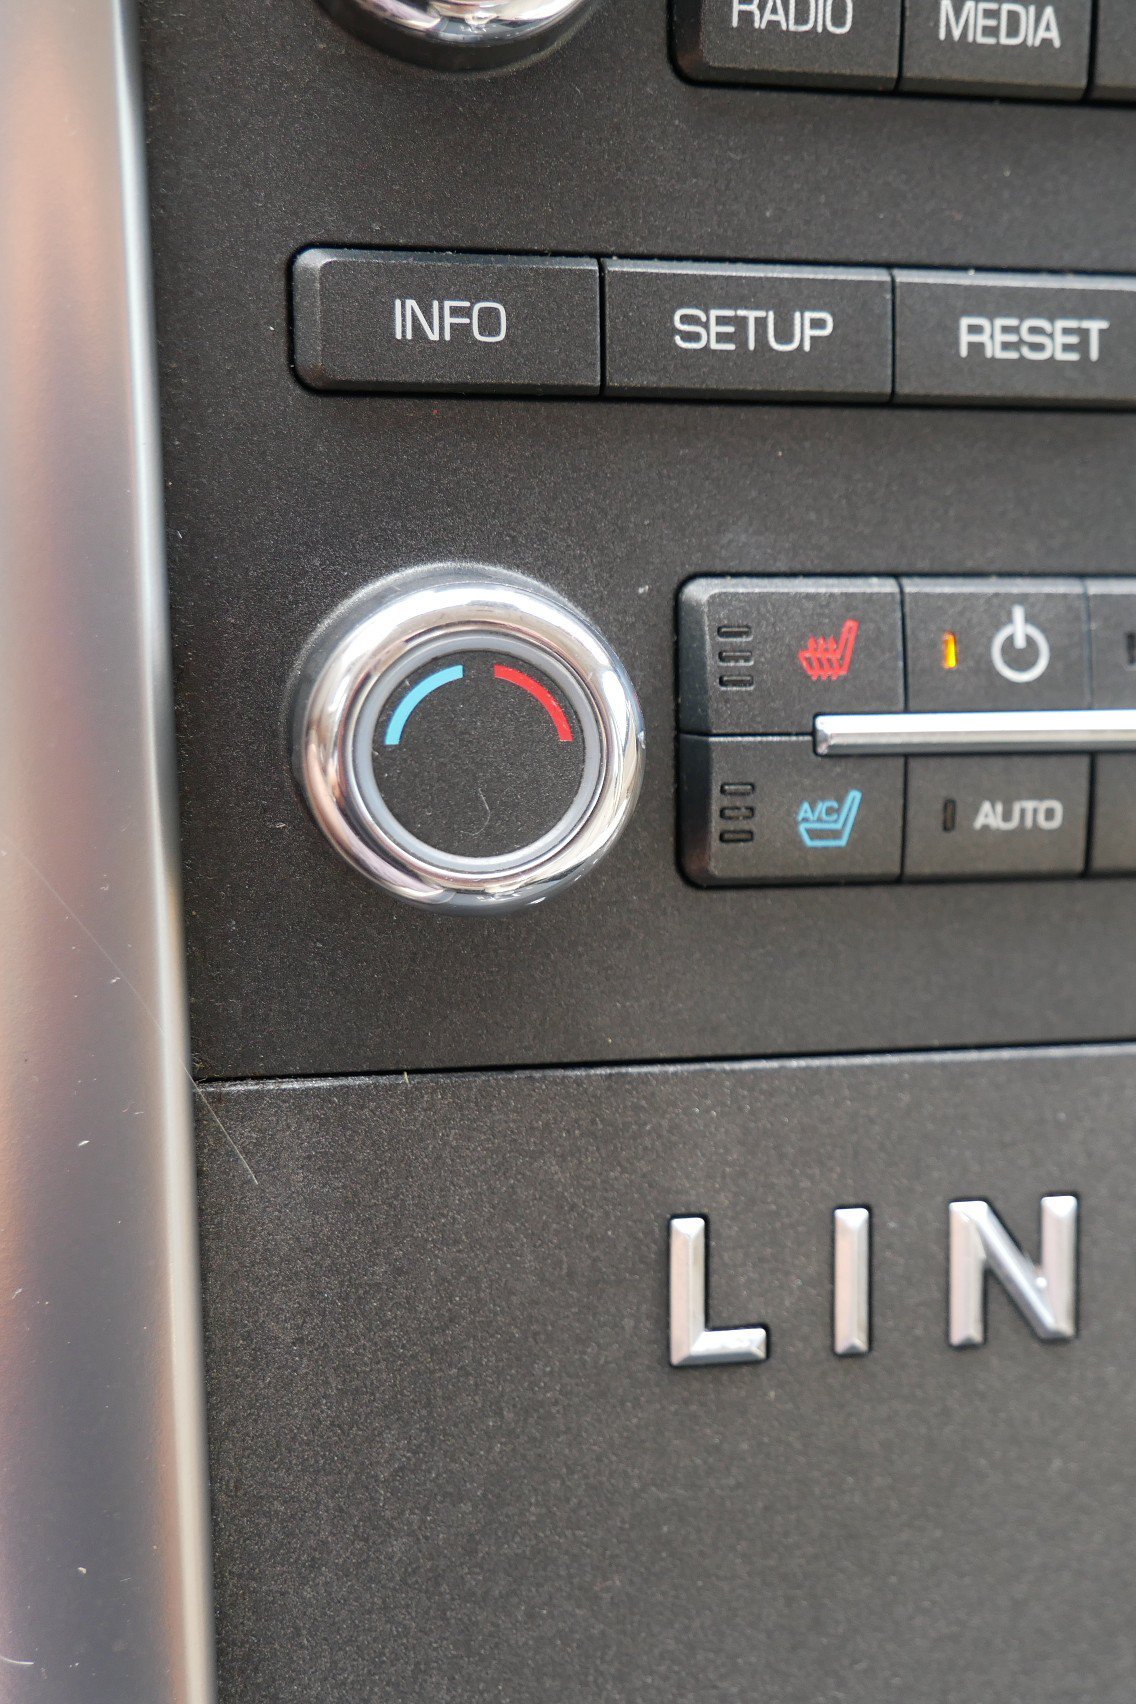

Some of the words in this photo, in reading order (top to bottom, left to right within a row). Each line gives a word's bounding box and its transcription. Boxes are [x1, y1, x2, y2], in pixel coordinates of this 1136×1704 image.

[731, 0, 853, 35] RADIO
[939, 0, 1060, 48] MEDIA
[394, 299, 506, 342] INFO
[674, 308, 833, 352] SETUP
[959, 316, 1109, 361] RESET
[798, 799, 839, 822] A/C
[974, 800, 1063, 830] AUTO
